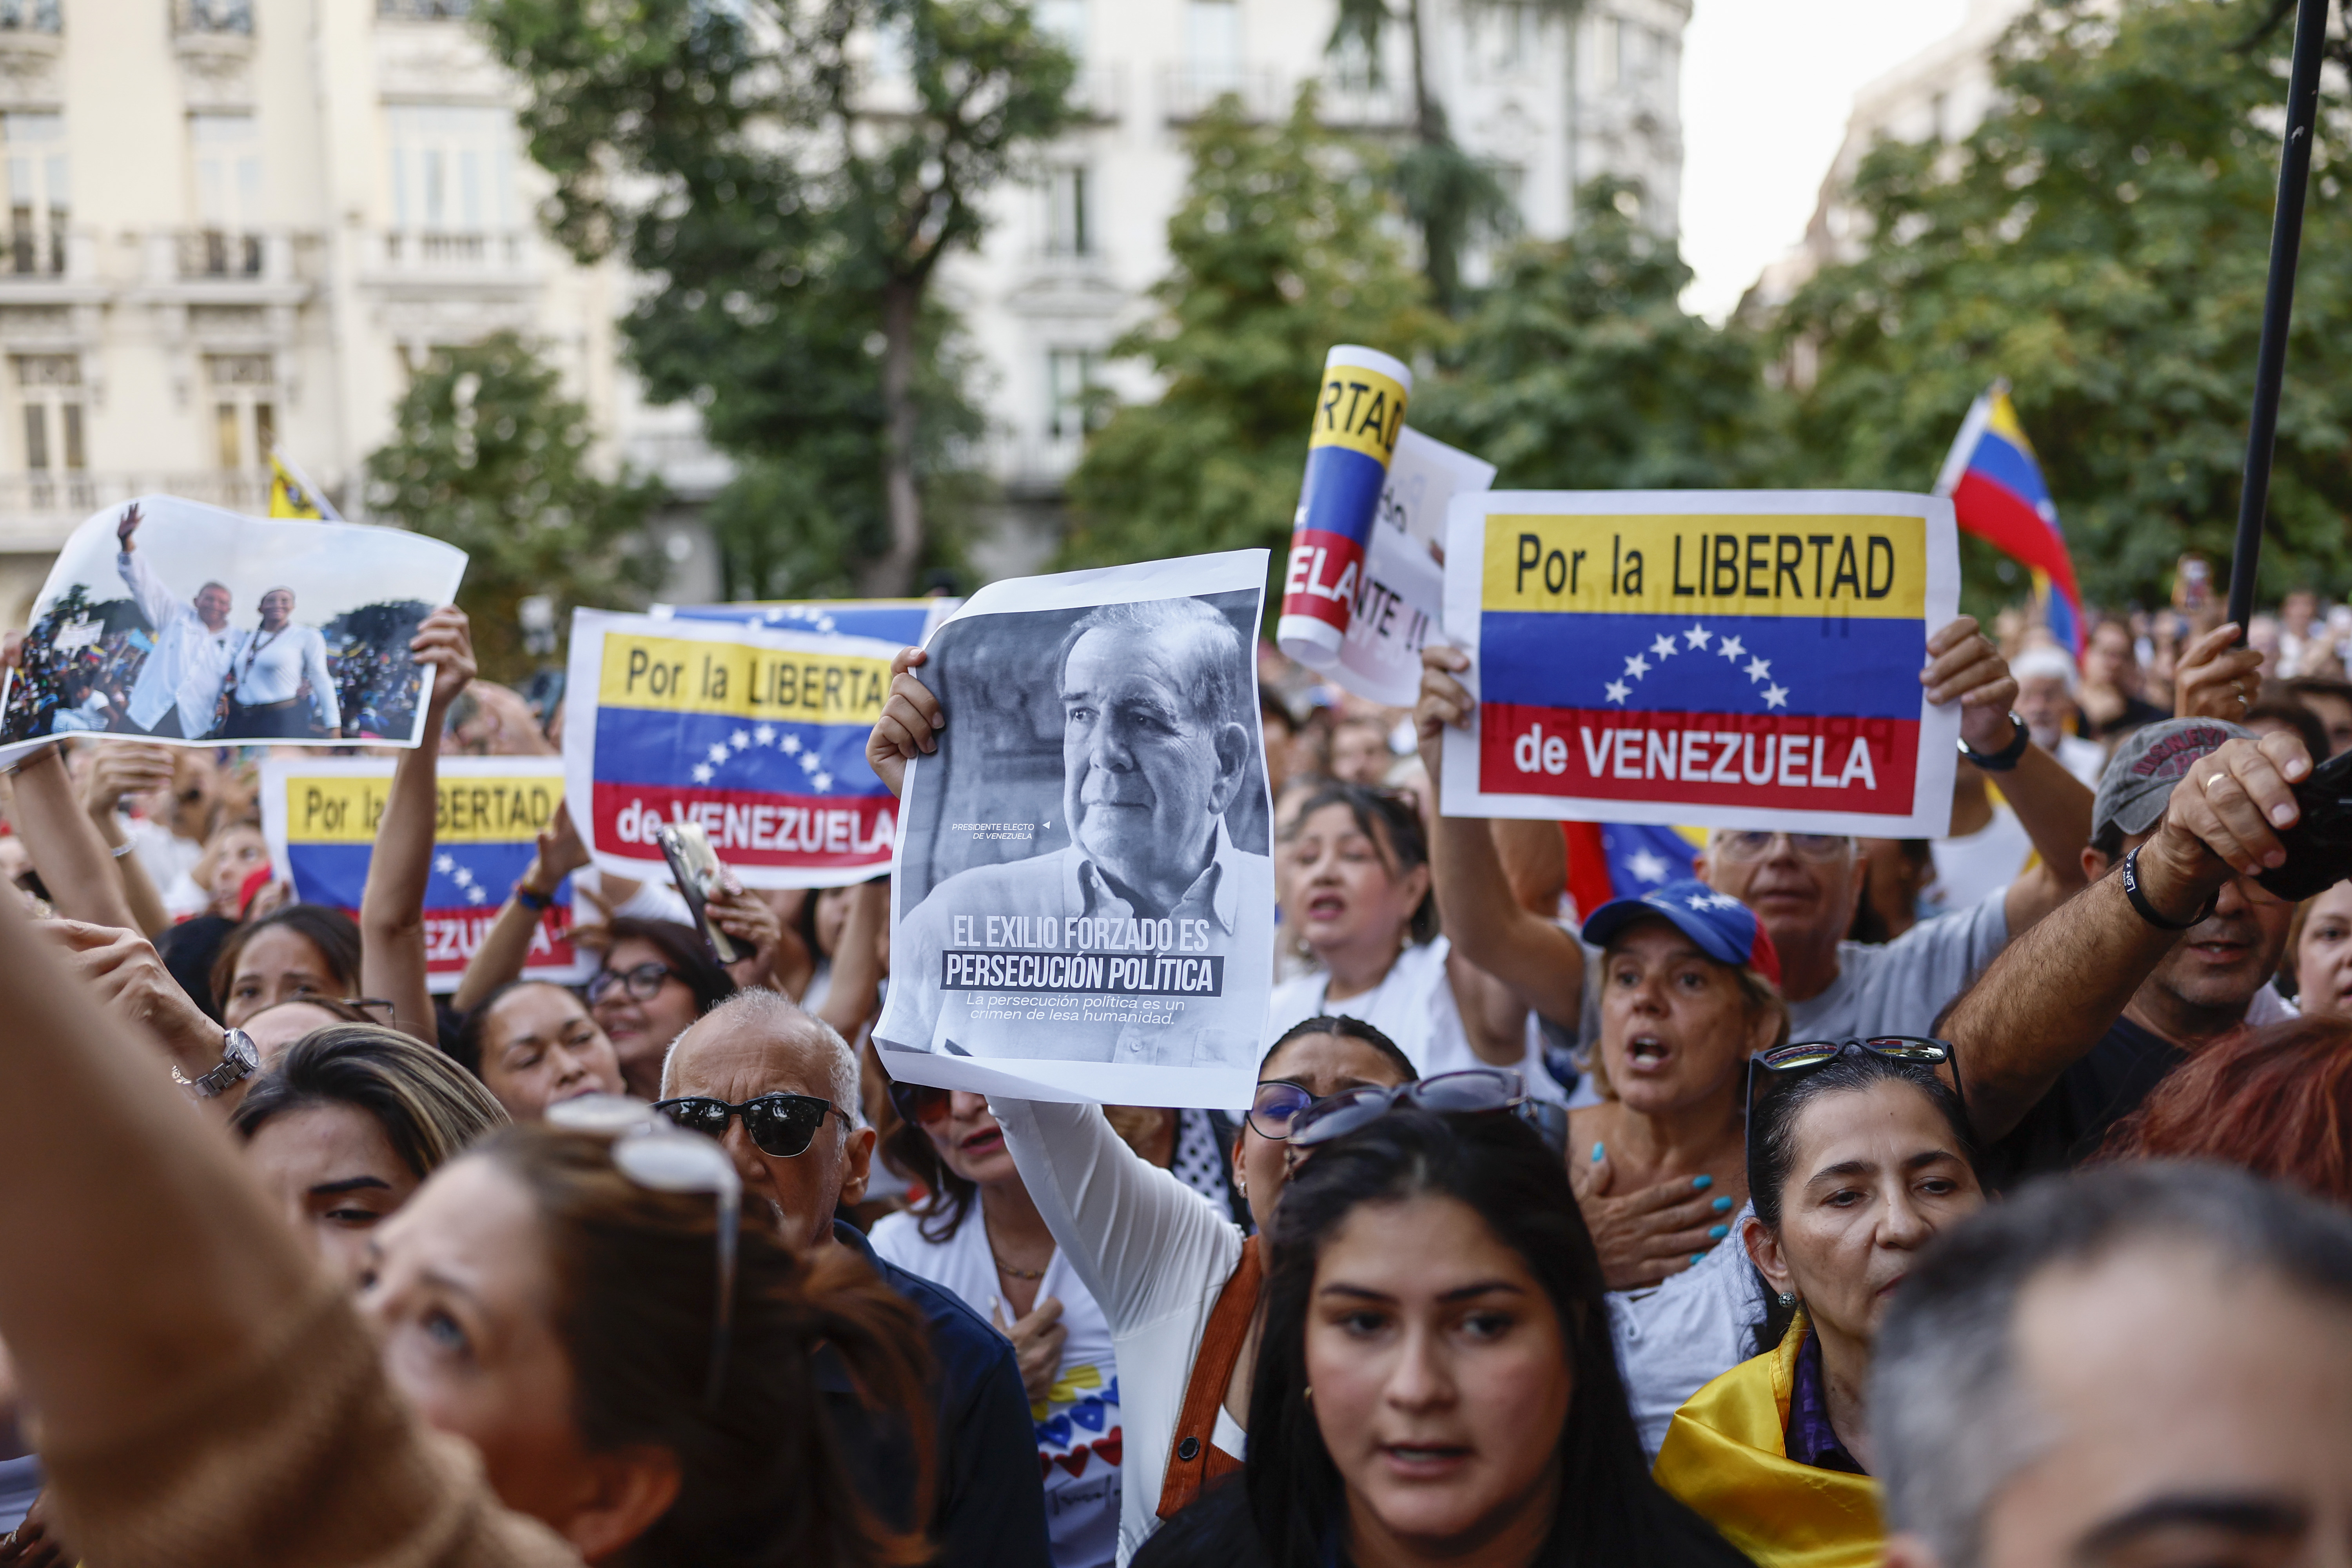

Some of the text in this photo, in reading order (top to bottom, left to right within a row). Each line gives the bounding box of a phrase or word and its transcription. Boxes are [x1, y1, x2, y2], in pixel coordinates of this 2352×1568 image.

[1516, 533, 1895, 601] Por la LIBERTAD
[626, 649, 892, 712] Por la LIBERTA
[1514, 722, 1877, 790] de VENEZUELA
[305, 786, 348, 832] Por
[436, 787, 550, 831] BERTAD
[616, 797, 896, 855] de VENEZUELA
[954, 915, 1210, 952] EL EXILIO FORZADO ES
[946, 951, 1213, 991] PERSECUCIÓN POLÍTICA
[966, 992, 1185, 1011] La persecución política es un
[970, 1008, 1175, 1025] crimen de lesa humanidad.
